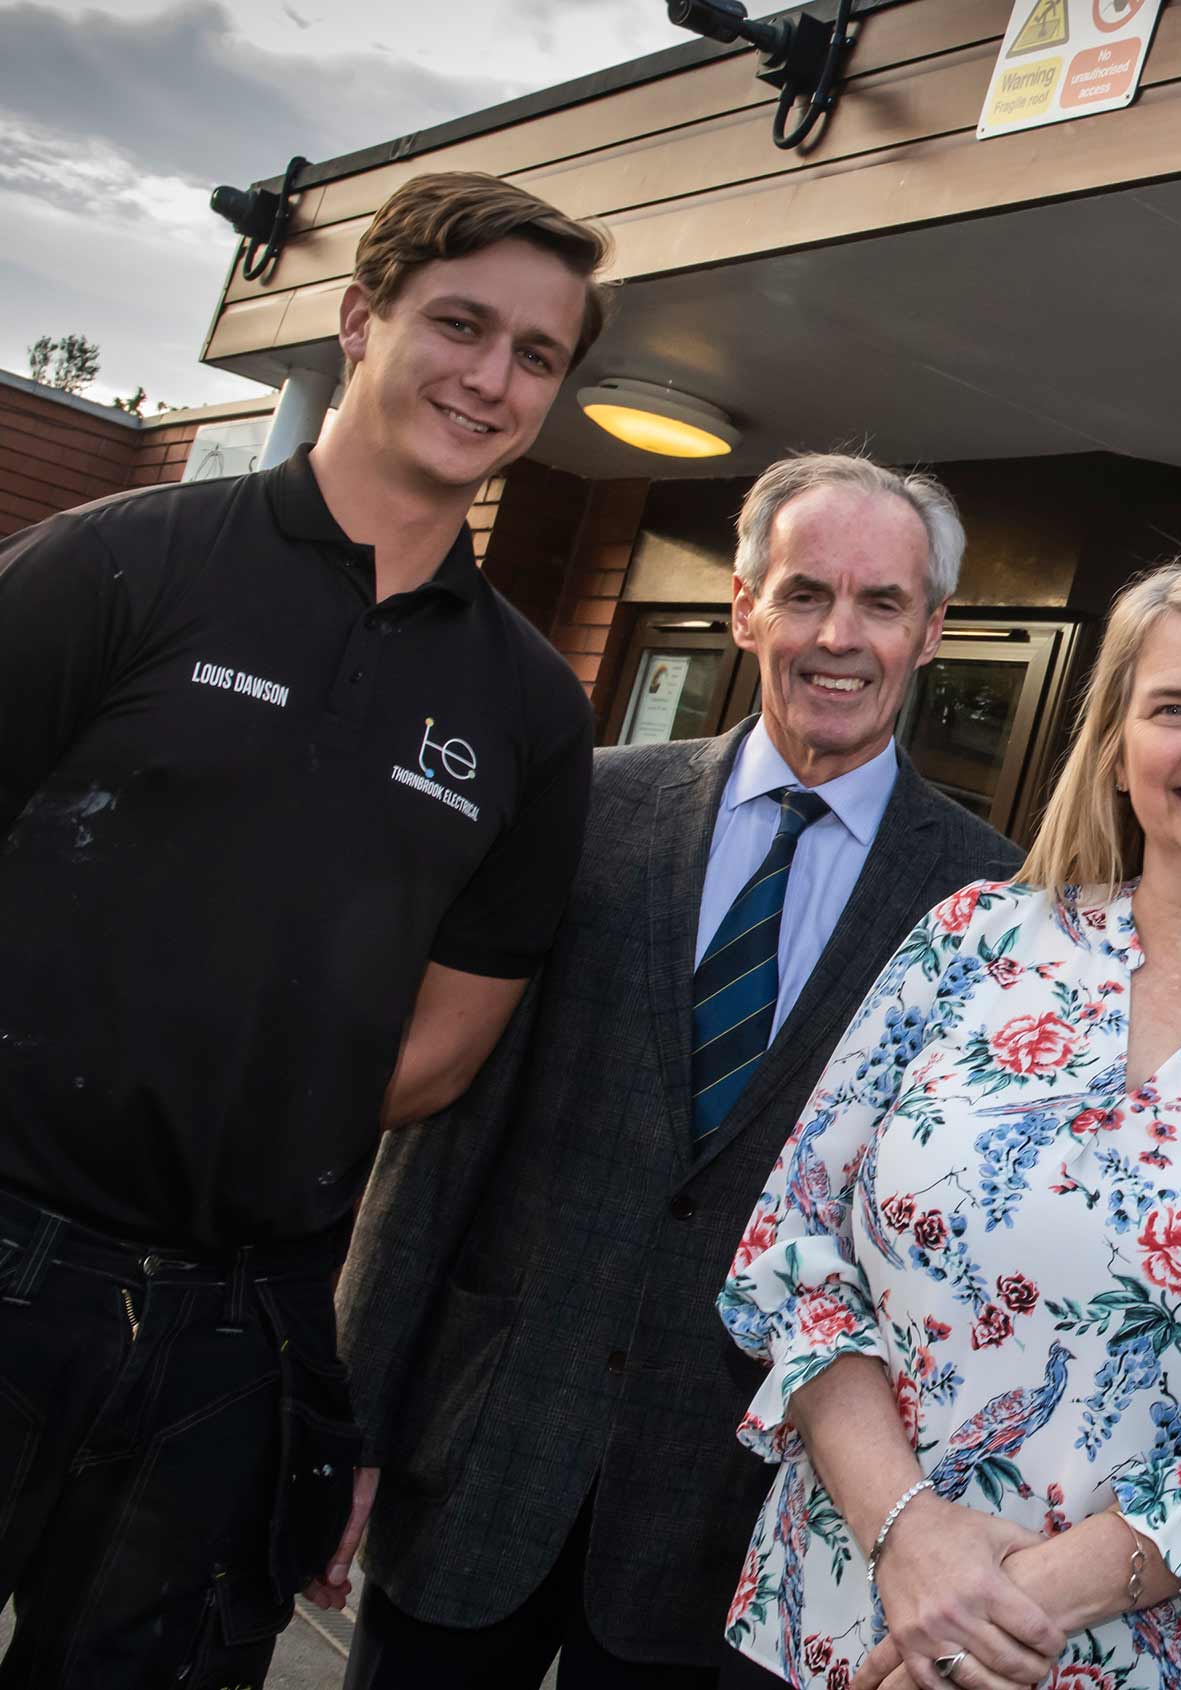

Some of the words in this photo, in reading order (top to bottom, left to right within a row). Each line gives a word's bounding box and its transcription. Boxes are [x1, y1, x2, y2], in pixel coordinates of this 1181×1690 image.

[1097, 49, 1112, 62] No
[1001, 66, 1056, 92] Warning
[1071, 60, 1130, 84] unauthorised
[1078, 83, 1111, 98] access
[993, 96, 1027, 115] Fragile
[191, 661, 234, 689] LOUIS
[233, 671, 290, 707] DAWSON
[391, 765, 444, 801] THORNBROOK
[443, 788, 480, 822] ELECTRICAL
